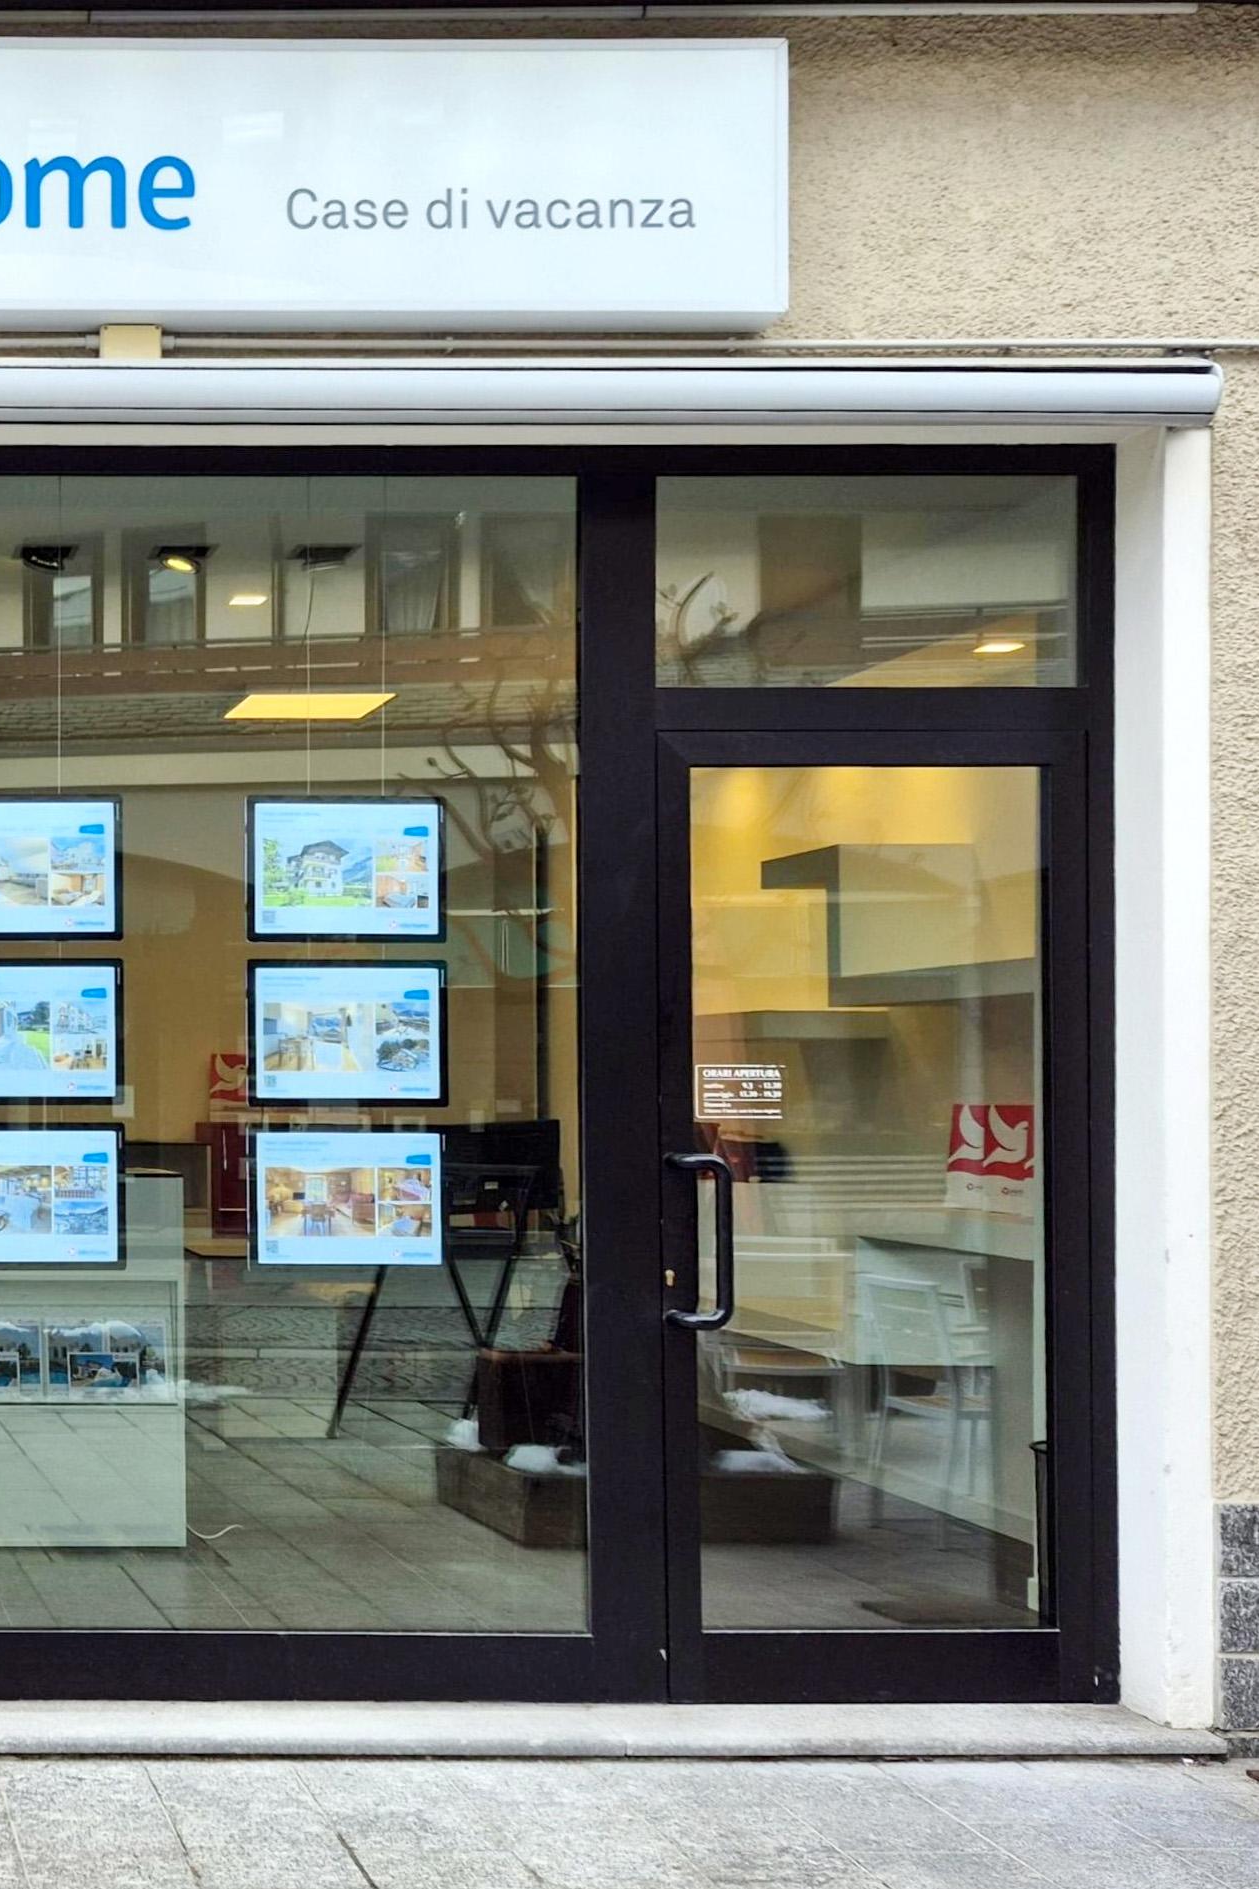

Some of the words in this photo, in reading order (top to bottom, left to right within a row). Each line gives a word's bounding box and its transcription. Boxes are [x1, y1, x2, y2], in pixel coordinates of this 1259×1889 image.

[286, 187, 409, 230] Case
[425, 187, 468, 230] di
[485, 197, 696, 230] vacanza
